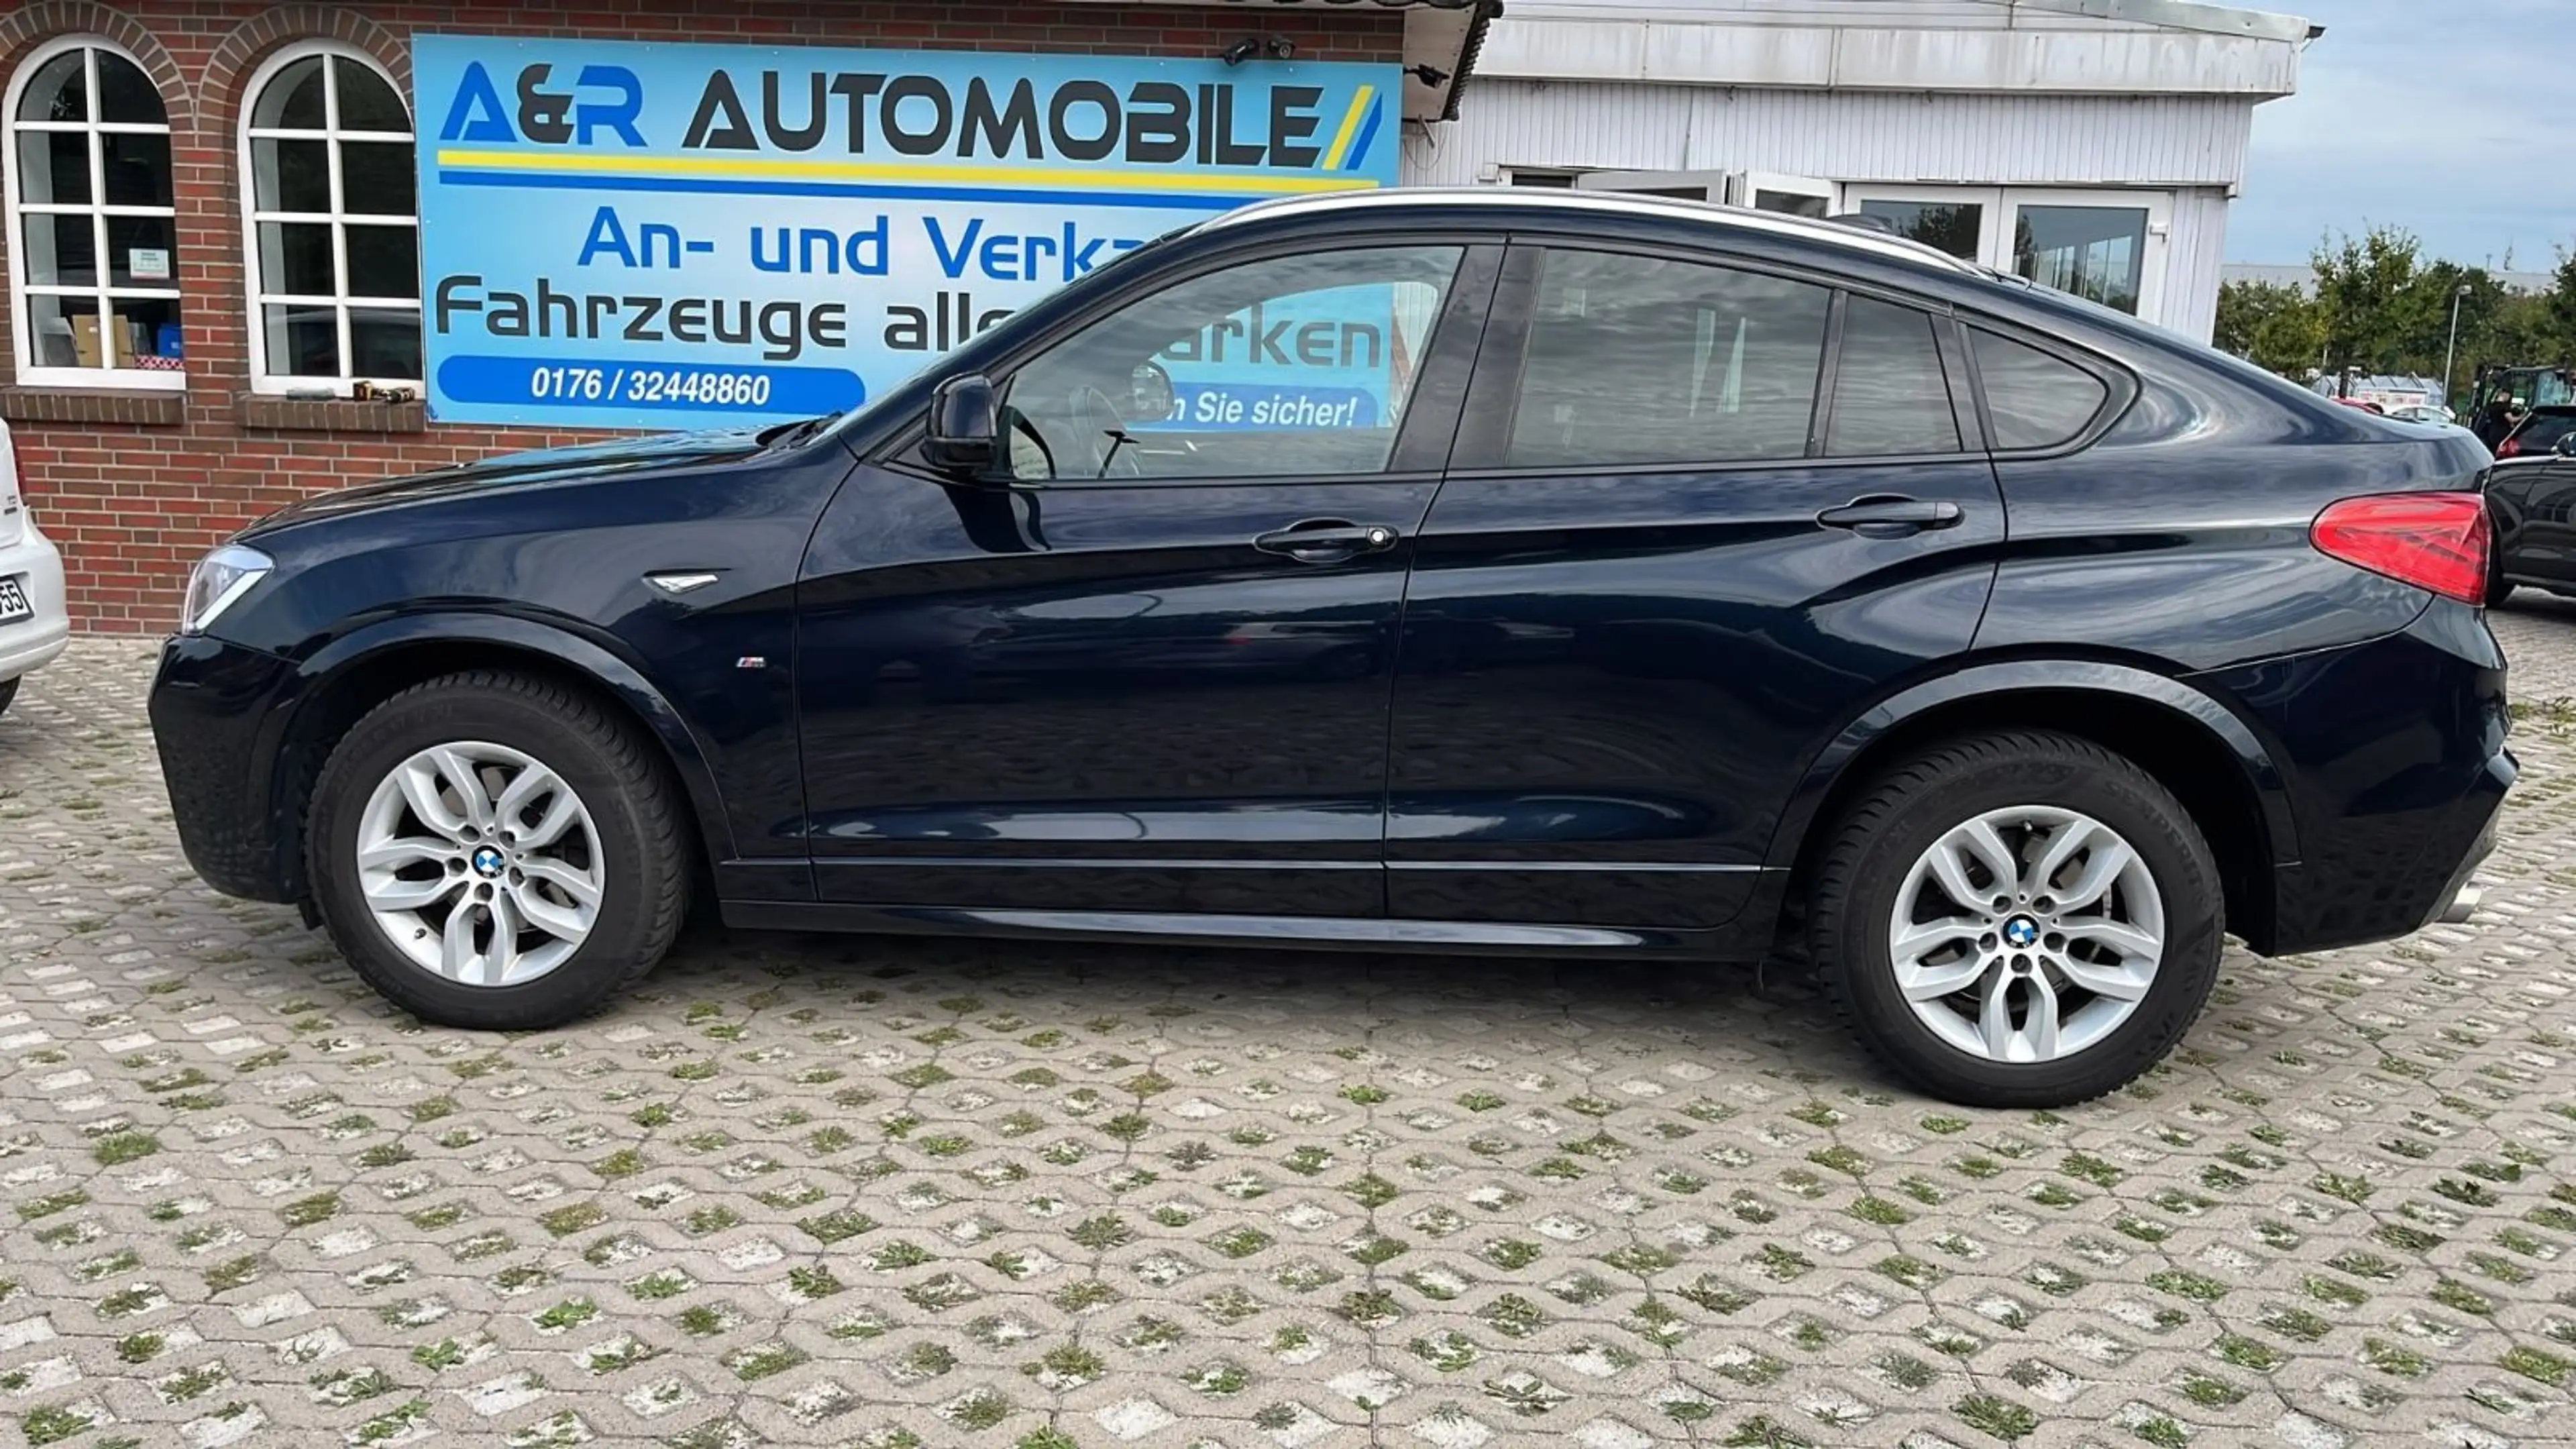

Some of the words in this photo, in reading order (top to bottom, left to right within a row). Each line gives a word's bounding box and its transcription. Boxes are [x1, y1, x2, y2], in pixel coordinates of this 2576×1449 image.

[439, 61, 648, 148] A&R
[682, 68, 1324, 168] AUTOMOBILE
[577, 205, 714, 269] An-
[751, 215, 890, 276] und
[435, 275, 847, 361] Fahrzeuge
[1159, 302, 1381, 368] arken
[531, 367, 603, 399] 0176
[607, 369, 624, 400] /
[627, 371, 771, 406] 32448860
[1195, 390, 1244, 423] Sie
[1251, 394, 1358, 427] sicher!
[0, 584, 24, 614] 55
